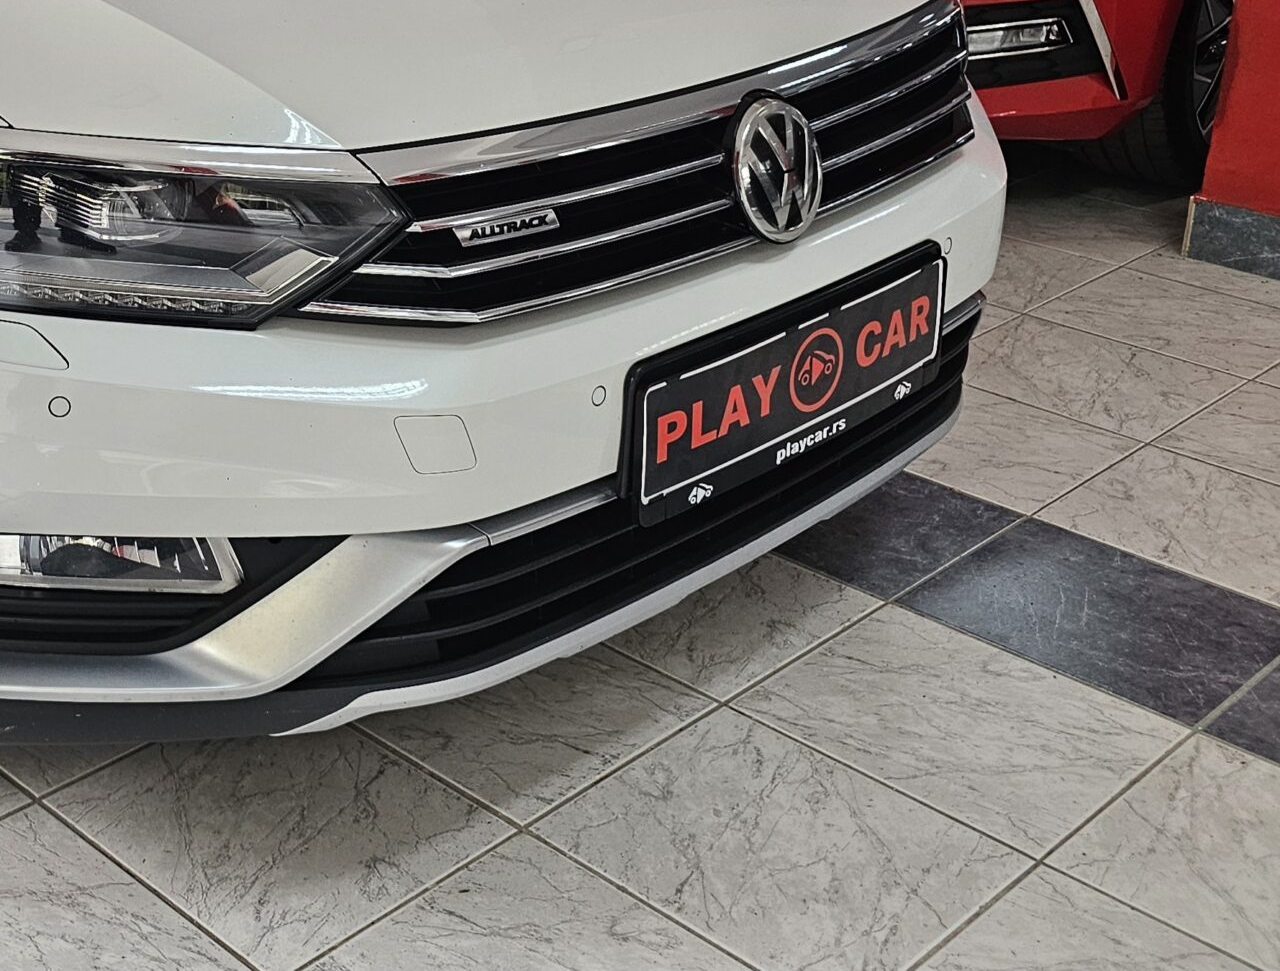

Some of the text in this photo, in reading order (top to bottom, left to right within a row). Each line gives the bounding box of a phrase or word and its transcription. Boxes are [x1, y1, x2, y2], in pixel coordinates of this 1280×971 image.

[468, 213, 551, 241] ALLTRACK
[656, 295, 931, 465] PLAY CAR
[775, 417, 847, 465] playcar.rs
